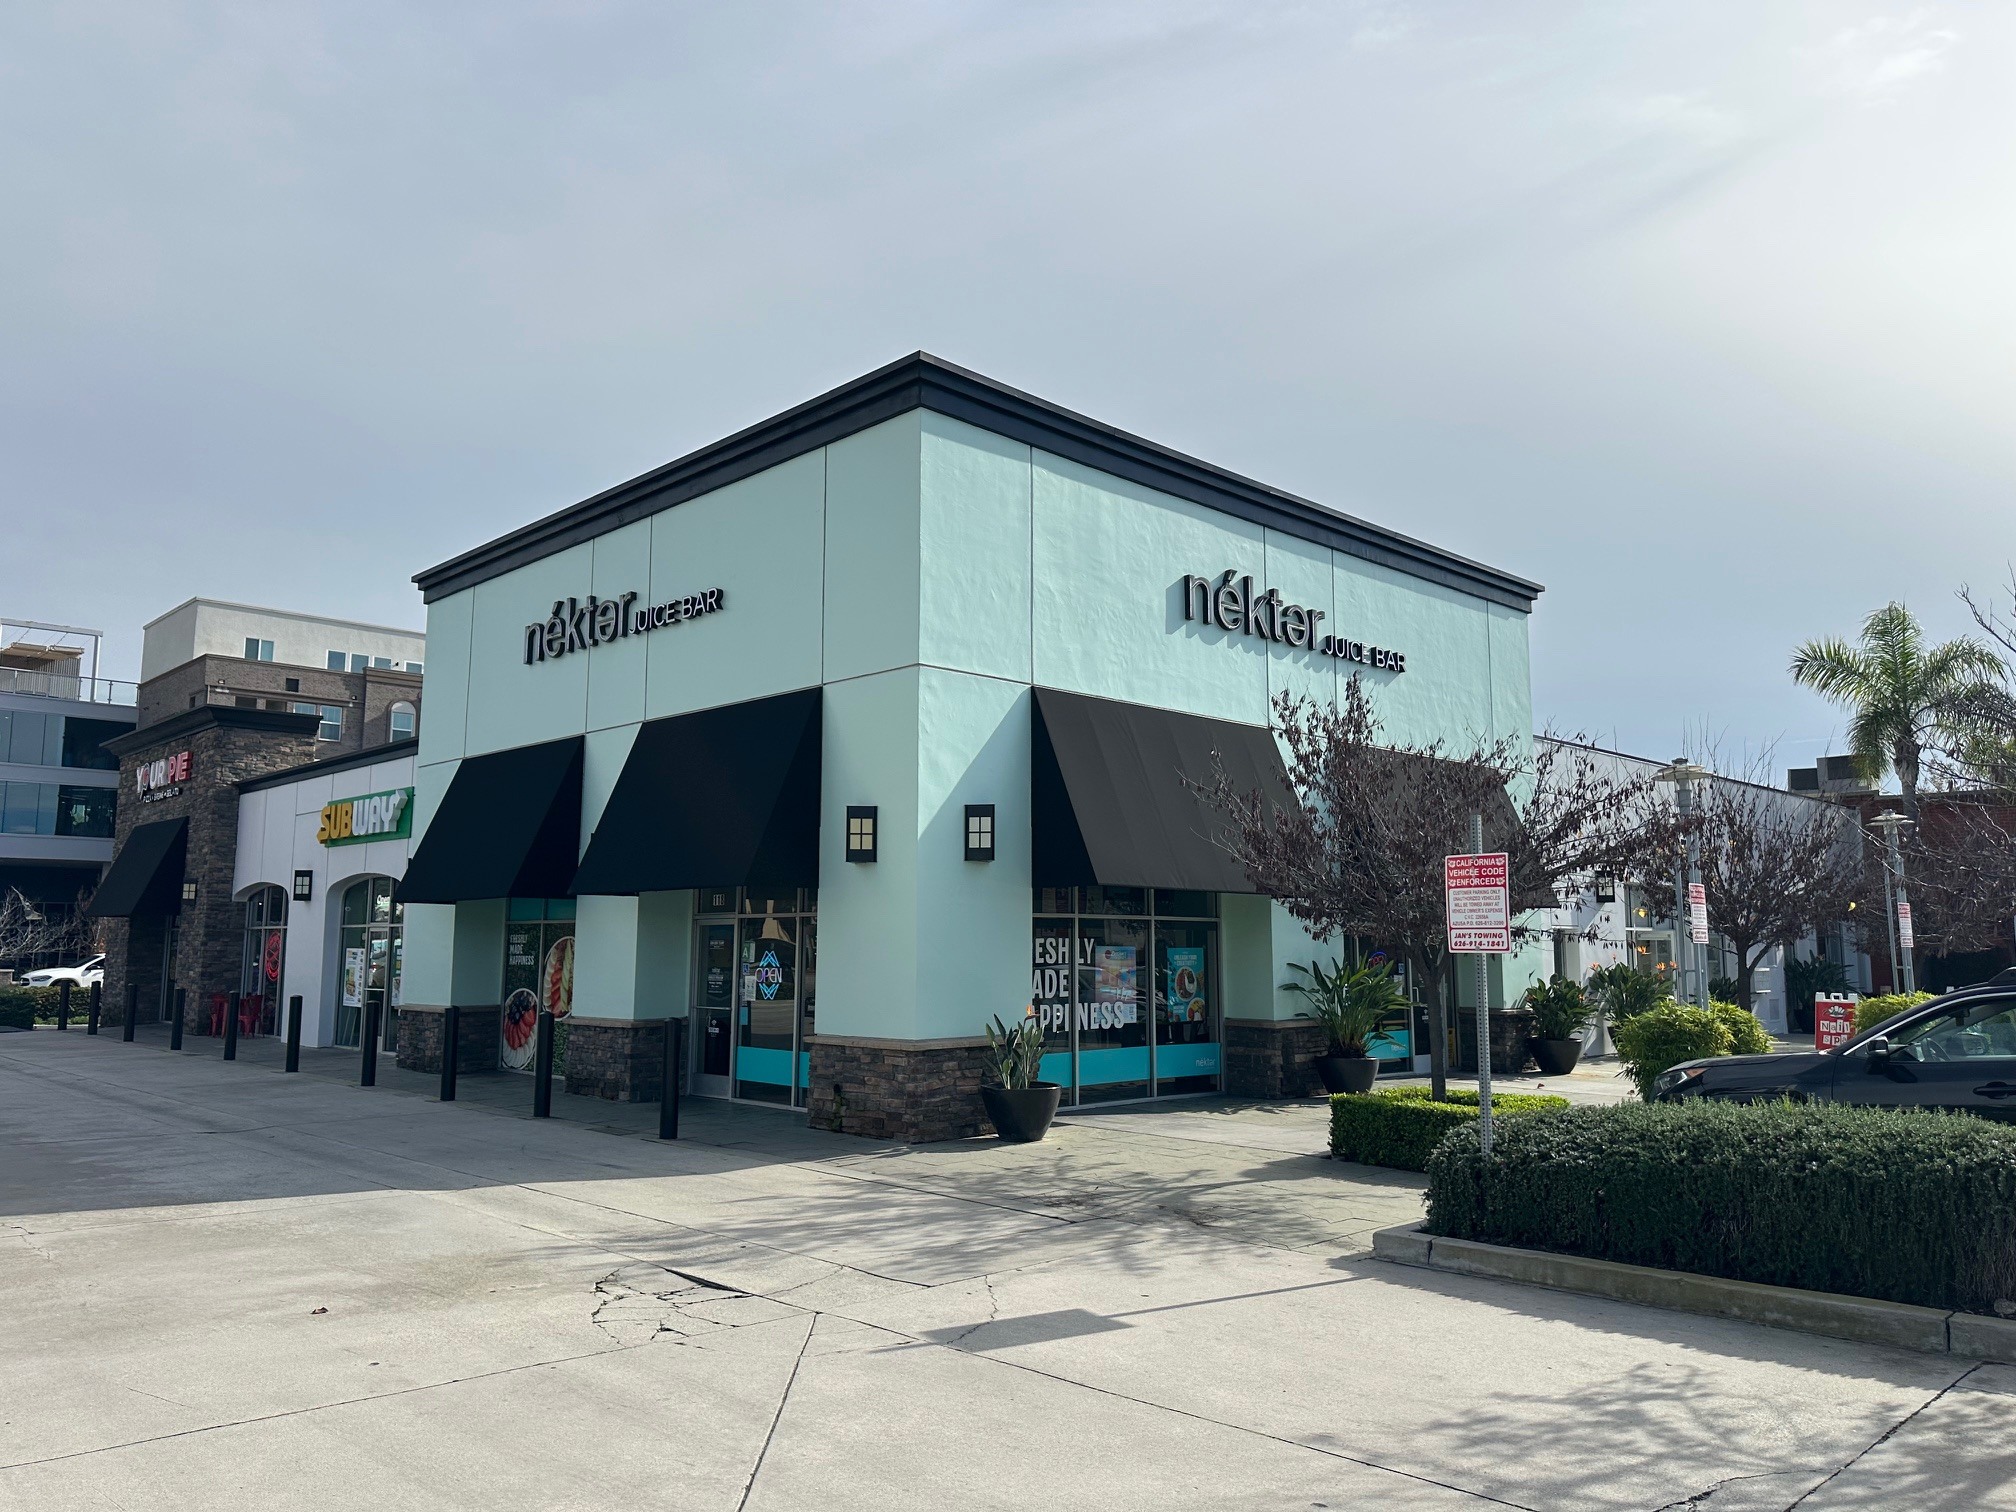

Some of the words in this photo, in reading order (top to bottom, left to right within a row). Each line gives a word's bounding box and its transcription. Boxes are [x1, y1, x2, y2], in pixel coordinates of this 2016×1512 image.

[629, 600, 680, 634] JUICE
[682, 587, 723, 619] BAR
[1323, 635, 1371, 664] JUICE
[1374, 647, 1406, 672] BAR
[137, 759, 167, 796] YOUR
[168, 751, 191, 784] PIE
[317, 789, 408, 844] SUBWAY
[1456, 858, 1496, 867] CALIFORNIA
[1449, 868, 1479, 877] VEHICLE
[1481, 867, 1504, 875] CODE
[1457, 878, 1495, 886] ENFORCED
[509, 944, 524, 954] MADE
[742, 946, 749, 958] A
[1035, 937, 1094, 964] ESHLY
[509, 955, 534, 966] HAPPINESS
[755, 967, 783, 983] OPEN
[1032, 969, 1069, 999] ADE
[1032, 1001, 1125, 1032] PPINESS
[1822, 1022, 1849, 1031] Nail
